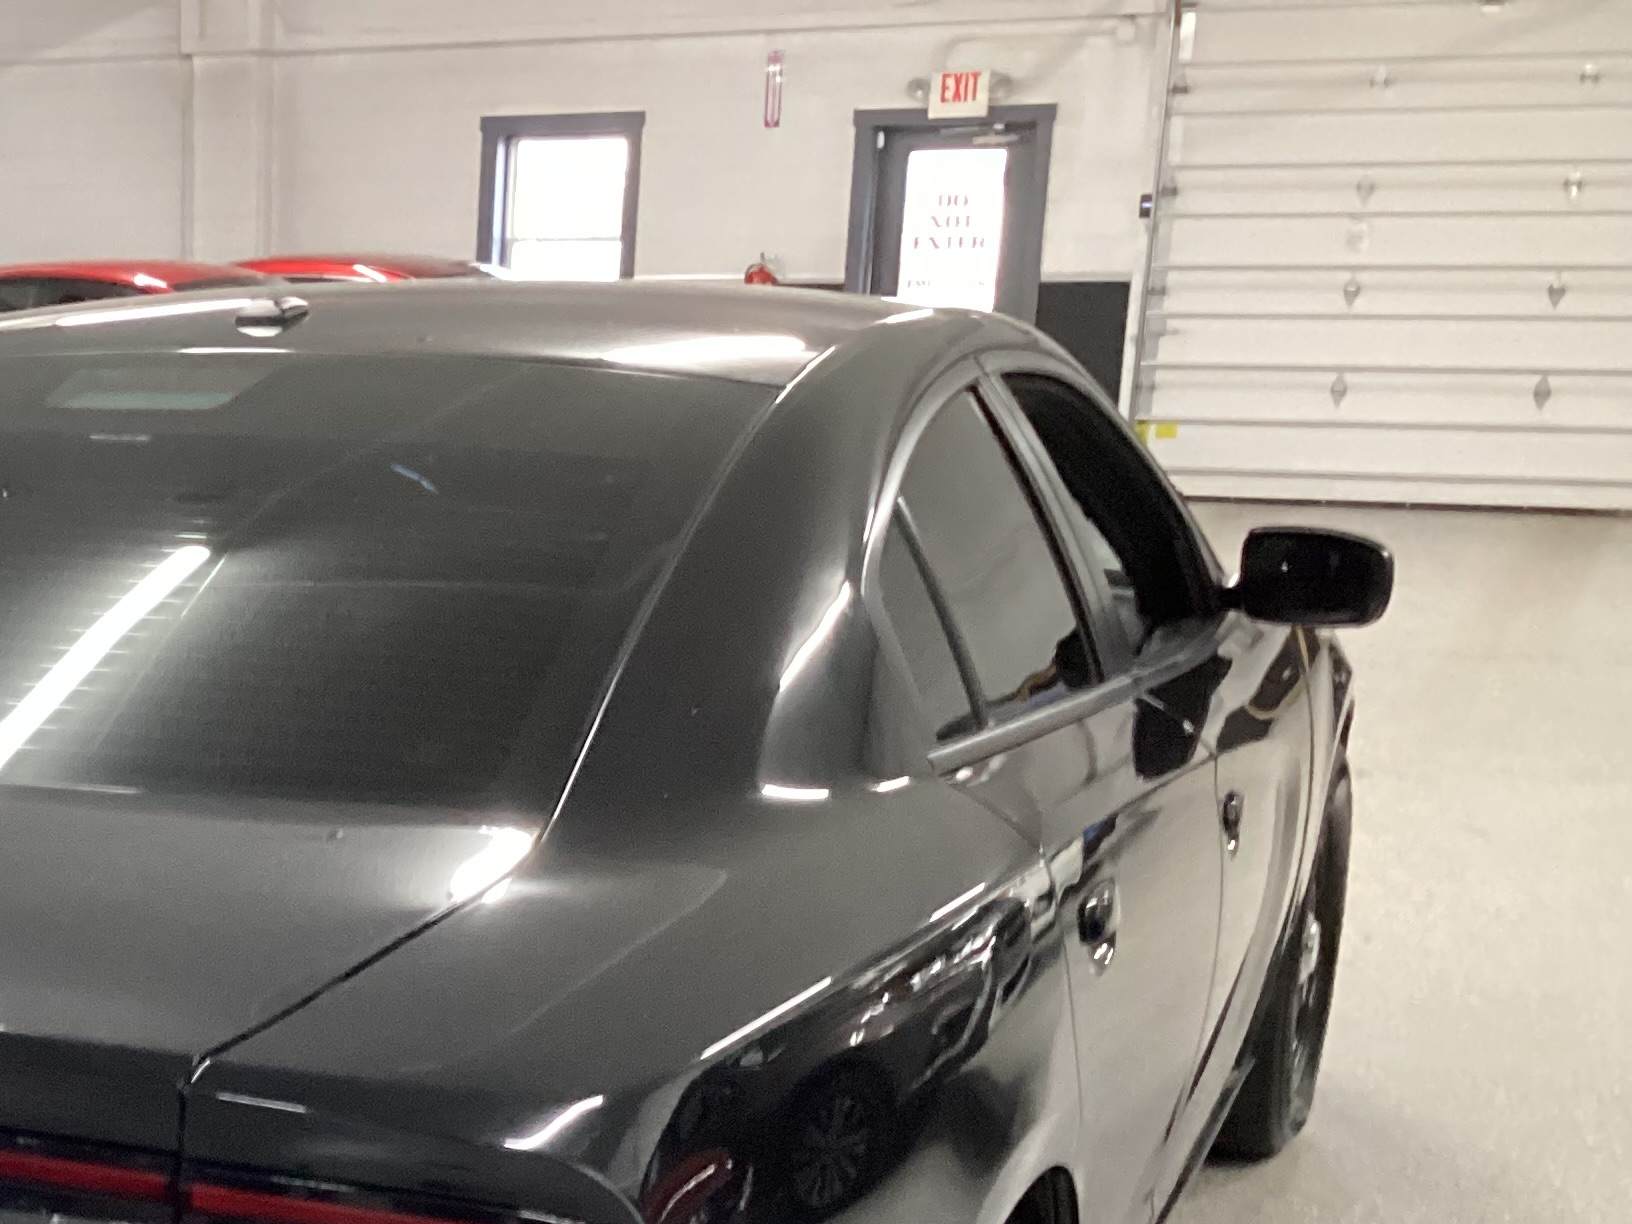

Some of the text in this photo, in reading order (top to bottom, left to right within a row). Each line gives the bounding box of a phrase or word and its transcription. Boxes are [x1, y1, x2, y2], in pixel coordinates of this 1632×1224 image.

[940, 71, 982, 103] EXIT
[938, 194, 969, 207] DO
[930, 215, 971, 228] NOT
[913, 236, 985, 250] ENTER
